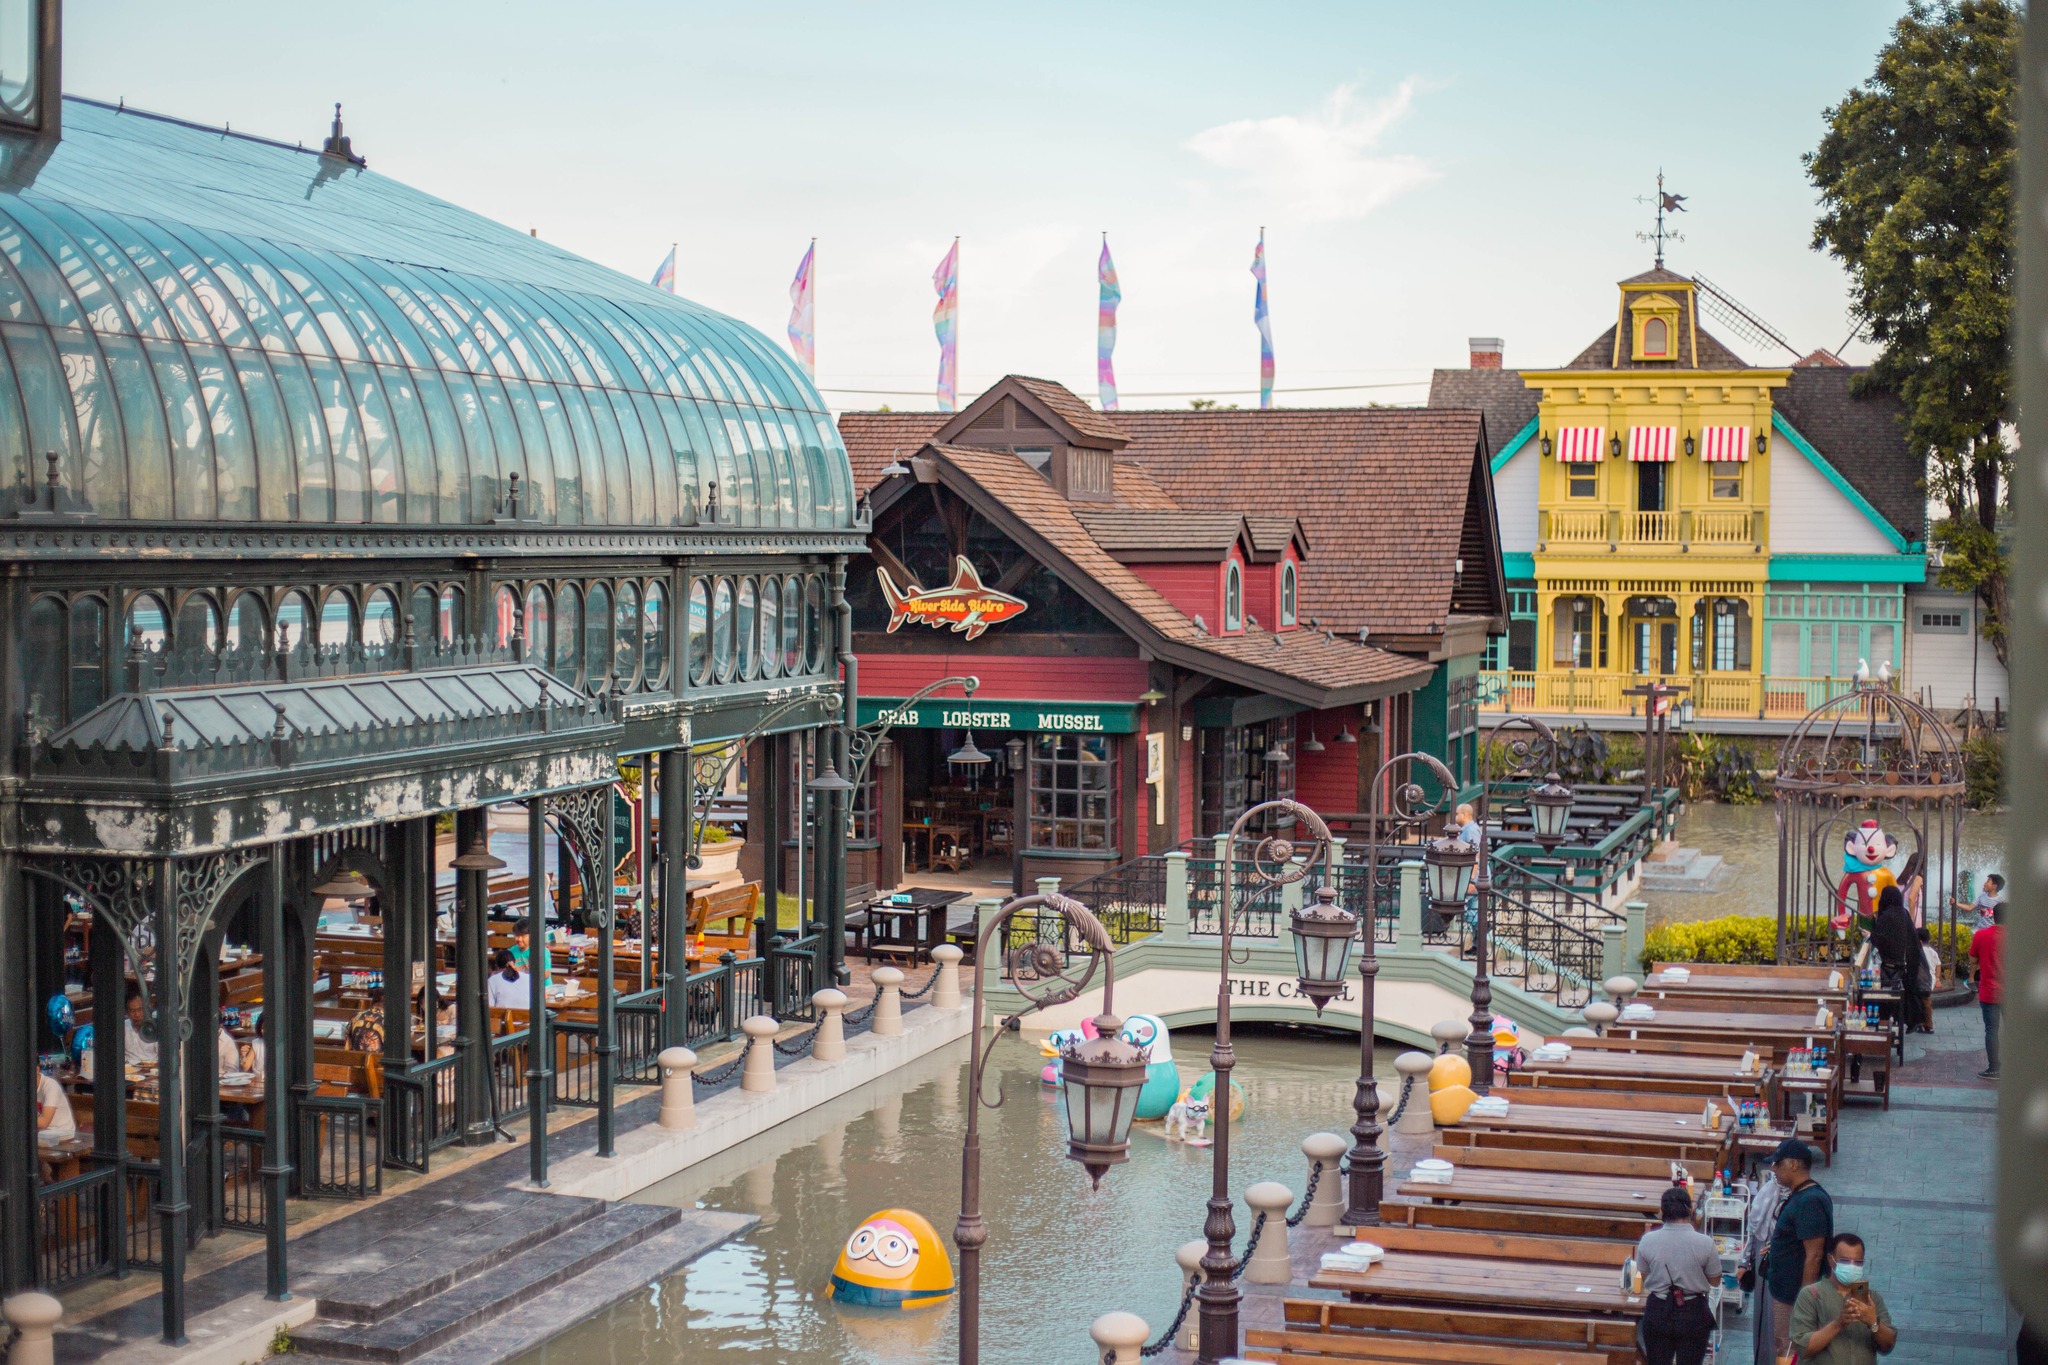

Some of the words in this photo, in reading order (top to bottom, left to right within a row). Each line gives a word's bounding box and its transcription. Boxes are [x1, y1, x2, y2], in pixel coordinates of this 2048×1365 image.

[968, 599, 1004, 612] Bistro
[878, 710, 919, 725] CRAB
[943, 711, 1011, 729] LOBSTER
[1038, 714, 1103, 731] MUSSEL
[1227, 979, 1270, 997] THE
